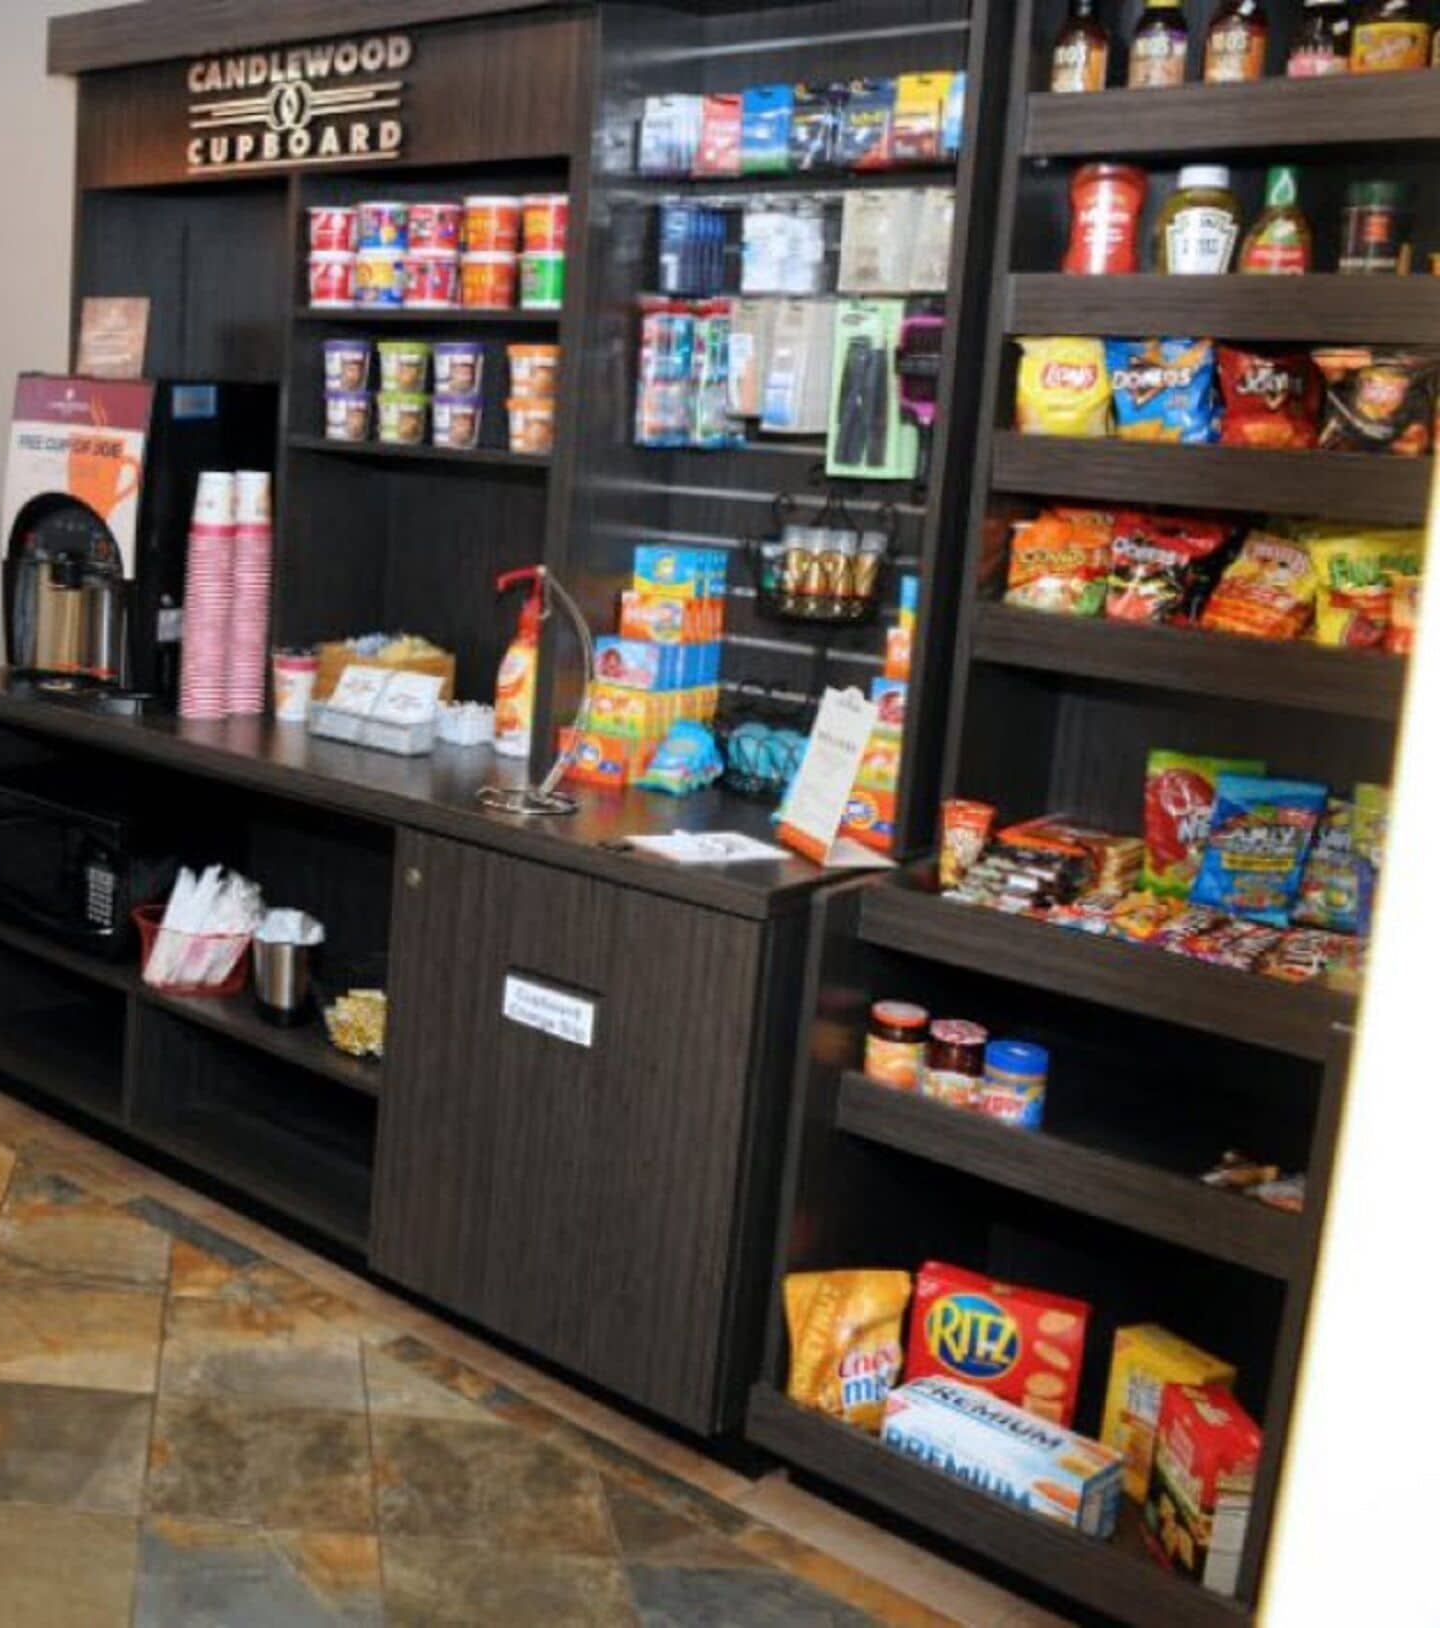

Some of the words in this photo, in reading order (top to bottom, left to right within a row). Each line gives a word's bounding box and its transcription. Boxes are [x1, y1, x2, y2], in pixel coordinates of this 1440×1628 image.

[187, 36, 412, 93] CANDLEWOOD
[187, 121, 402, 166] CUPBOARD
[928, 1297, 1016, 1365] RITZ
[915, 1377, 1065, 1449] PREMIUM
